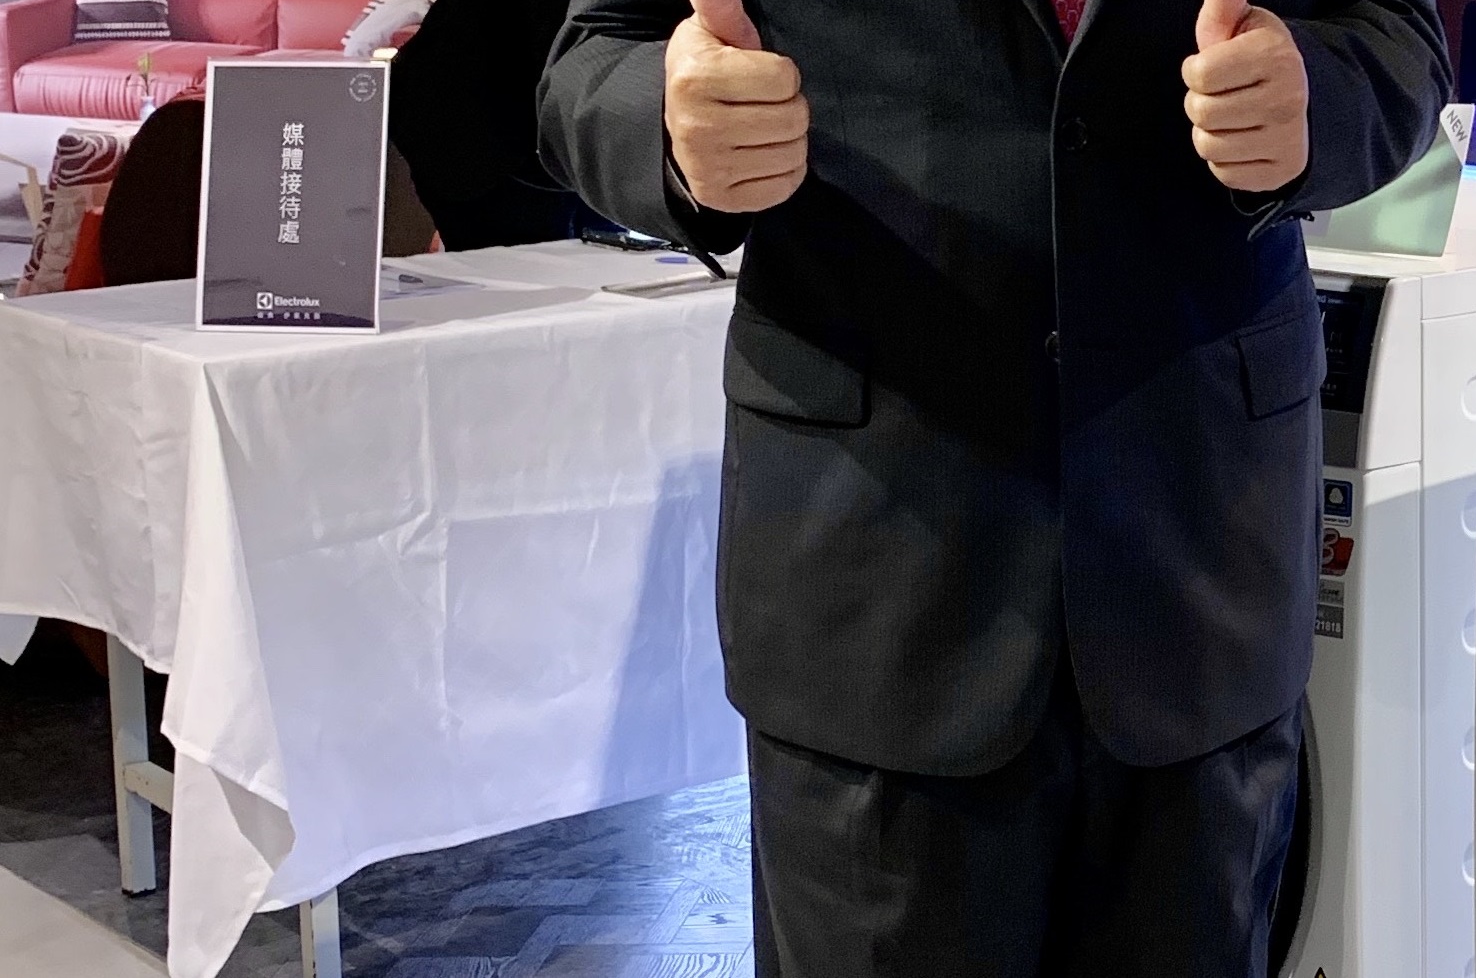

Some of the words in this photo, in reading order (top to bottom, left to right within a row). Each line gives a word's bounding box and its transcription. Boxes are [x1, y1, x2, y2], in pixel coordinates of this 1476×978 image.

[1446, 109, 1469, 142] NEW
[278, 122, 305, 244] 媒體接待處
[273, 295, 320, 307] Electrolux
